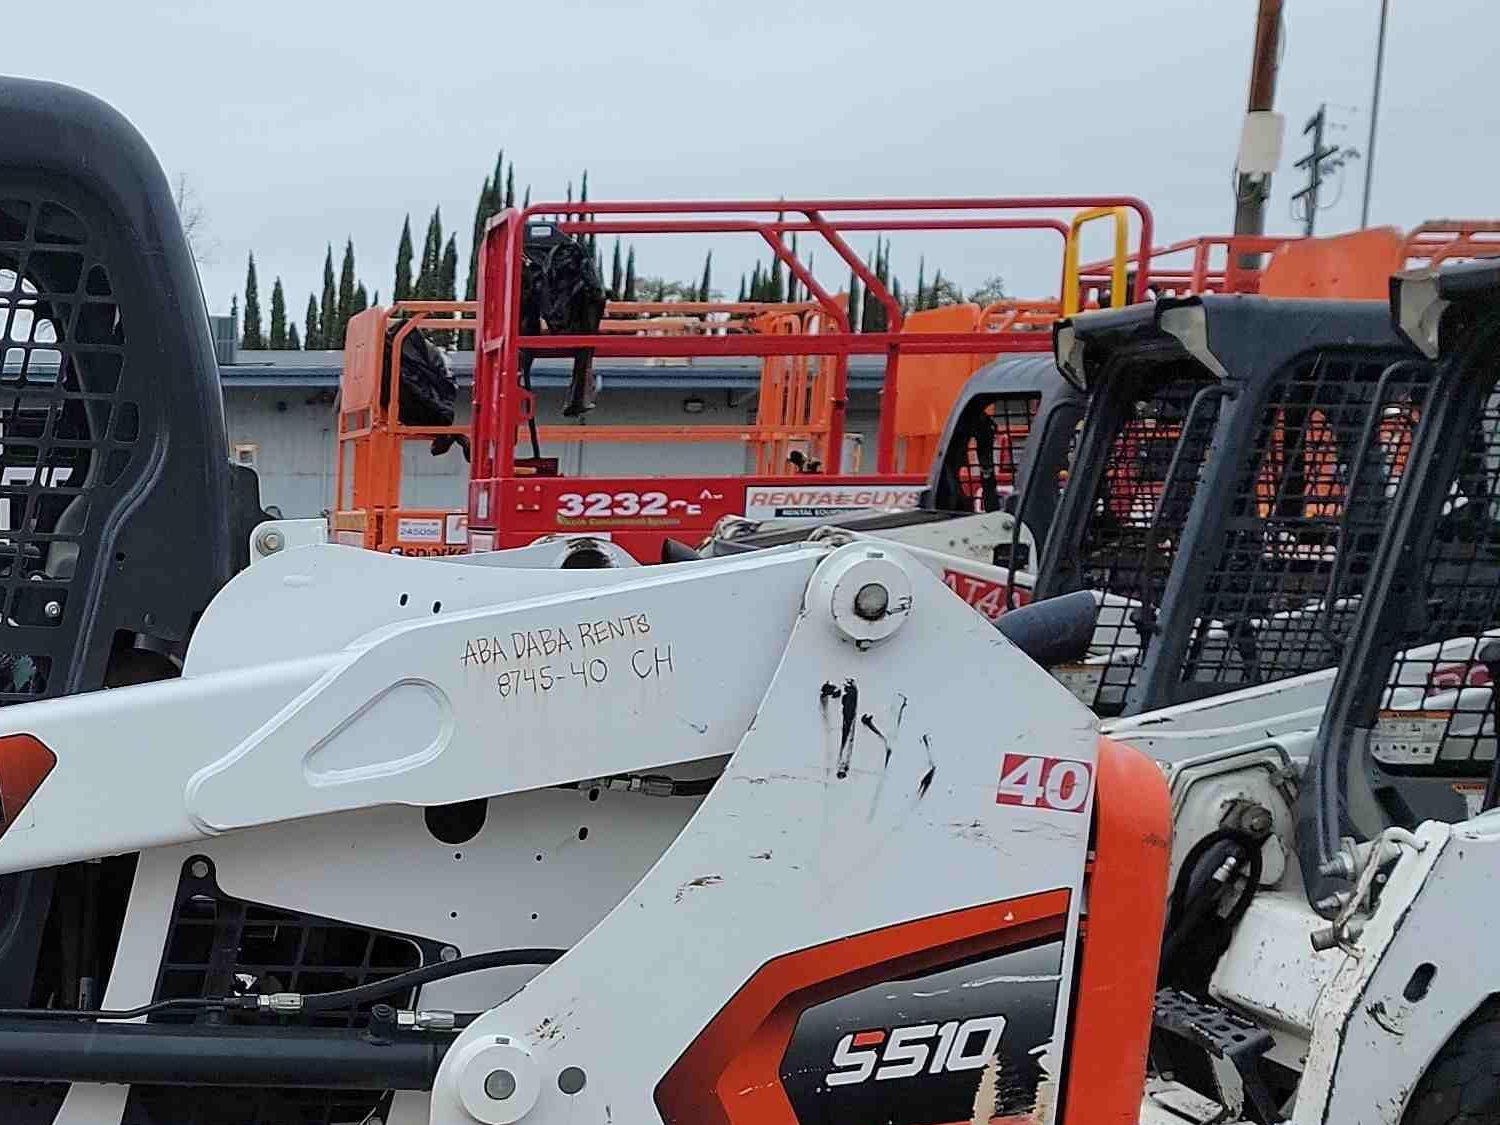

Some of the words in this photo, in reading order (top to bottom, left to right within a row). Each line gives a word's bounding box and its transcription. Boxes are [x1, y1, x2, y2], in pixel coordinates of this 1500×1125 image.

[461, 636, 507, 667] ABA
[512, 627, 573, 660] DABA
[578, 613, 651, 648] RENTS
[498, 658, 608, 698] 8745-40
[632, 644, 674, 680] CH
[999, 756, 1090, 811] 40
[826, 1015, 1007, 1086] S510
